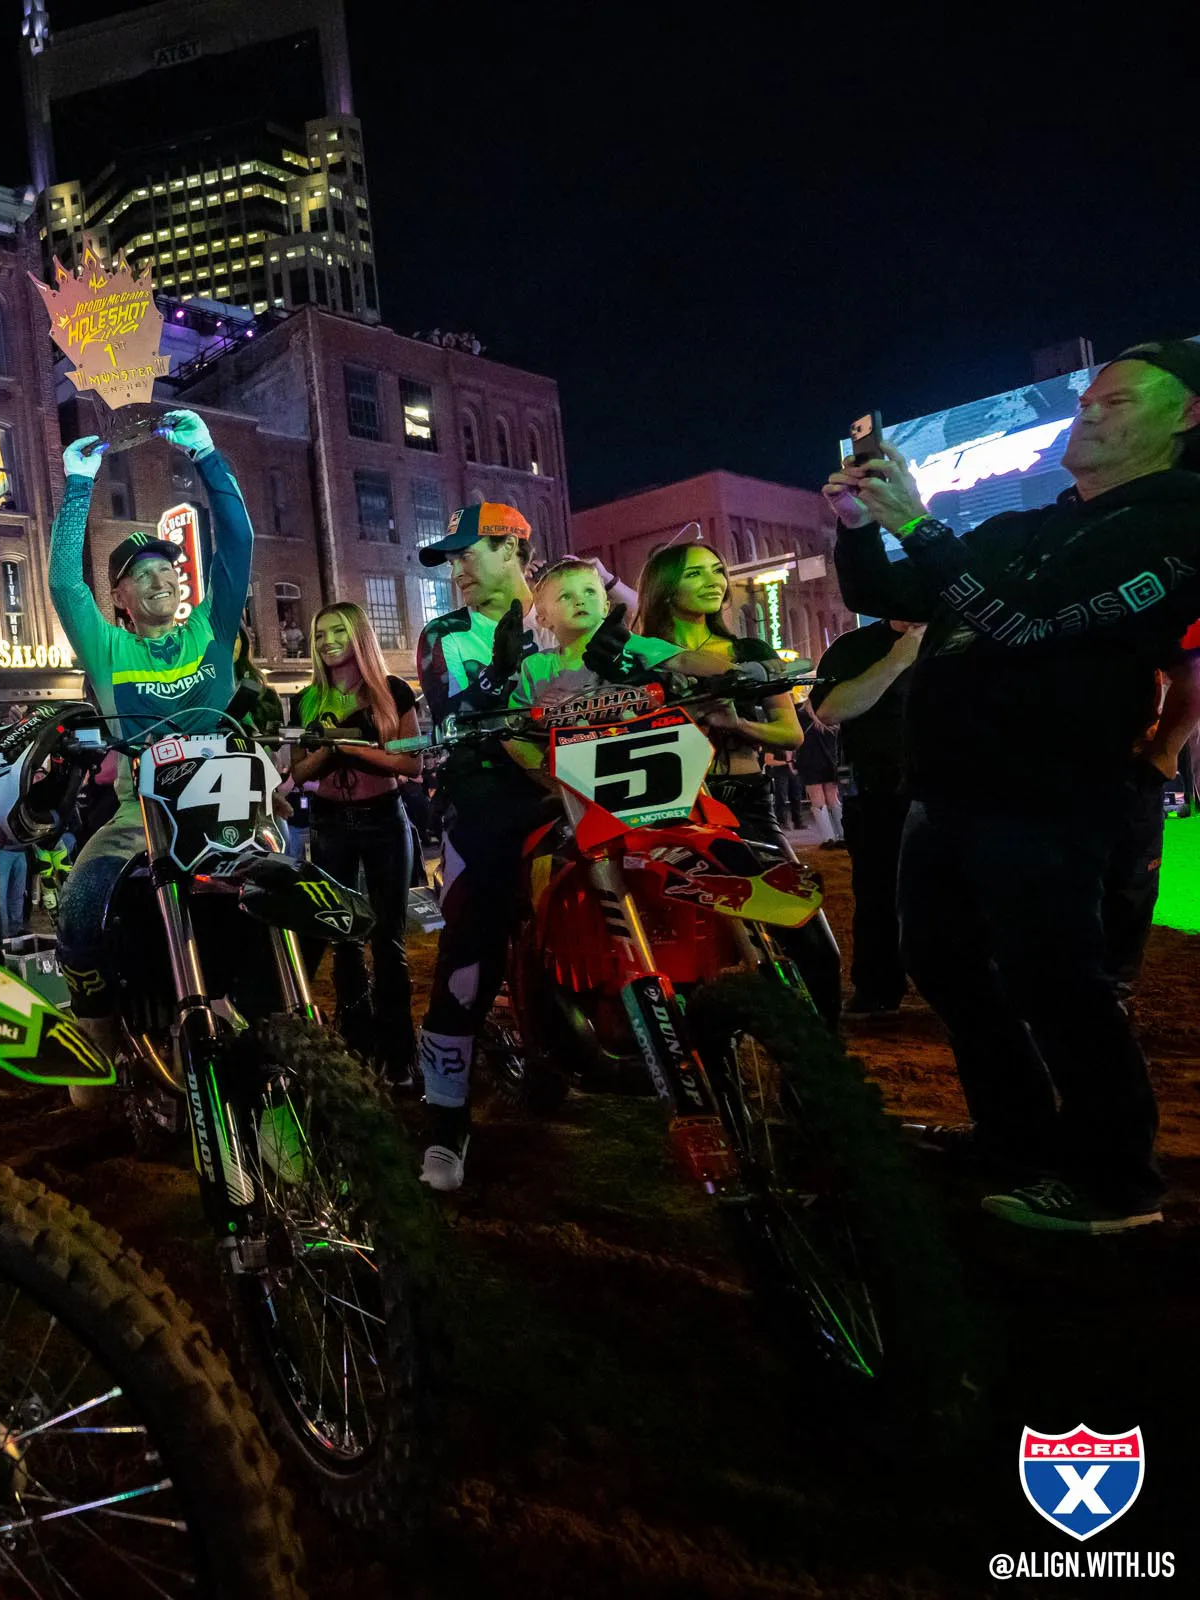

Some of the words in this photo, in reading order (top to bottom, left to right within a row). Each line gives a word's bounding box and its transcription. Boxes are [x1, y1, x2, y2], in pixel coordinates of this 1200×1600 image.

[68, 301, 150, 346] HOLESHOT
[89, 366, 155, 386] MONSTER
[161, 511, 192, 533] LUCKY
[7, 564, 17, 606] LIVE
[171, 527, 193, 627] SALOO
[135, 671, 205, 696] TRIUMPH
[0, 716, 42, 749] MONSTER
[177, 758, 263, 823] 4
[594, 730, 683, 814] 5
[639, 808, 688, 823] MOTOREX
[651, 1004, 703, 1106] DUNOP
[186, 1071, 216, 1183] DUNLOP
